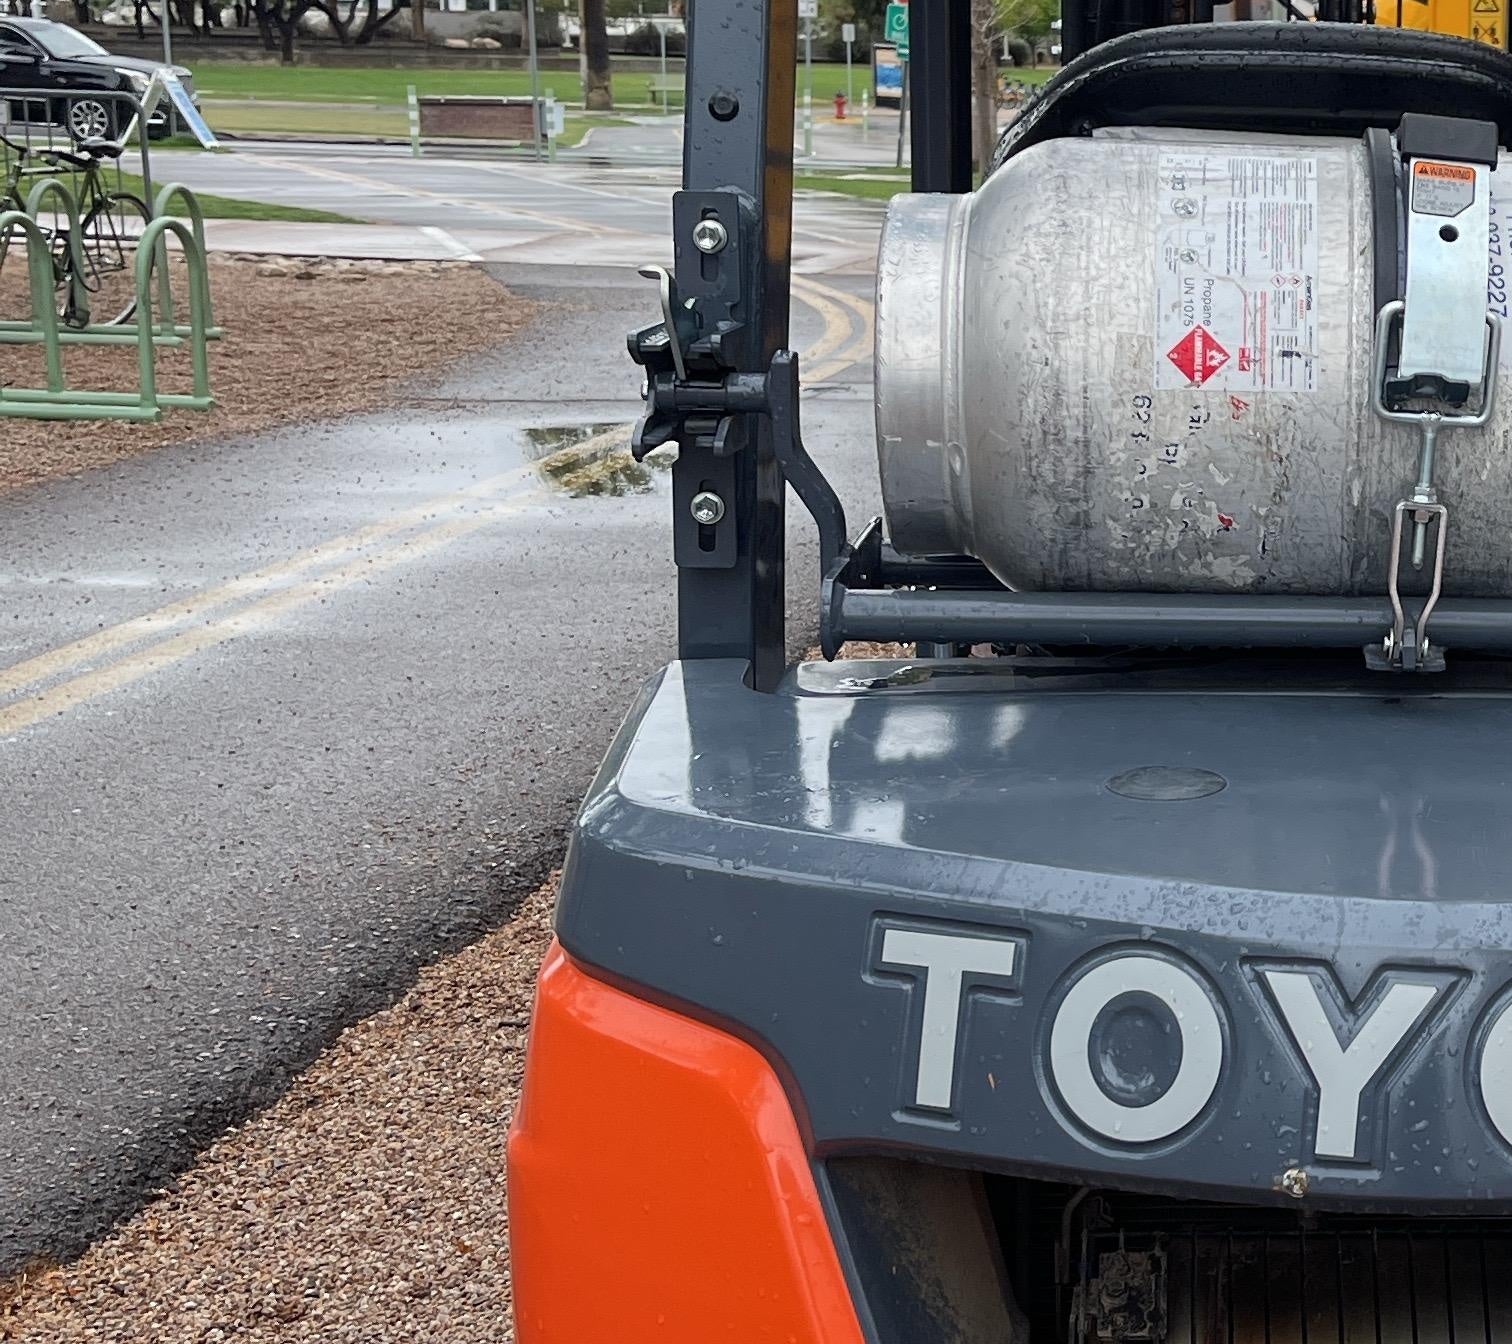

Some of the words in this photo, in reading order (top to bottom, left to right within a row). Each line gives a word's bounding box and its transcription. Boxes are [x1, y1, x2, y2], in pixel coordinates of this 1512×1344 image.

[1428, 166, 1472, 180] WARNING
[1183, 277, 1195, 295] UN
[1183, 299, 1195, 326] 1075
[1199, 278, 1214, 326] Propane
